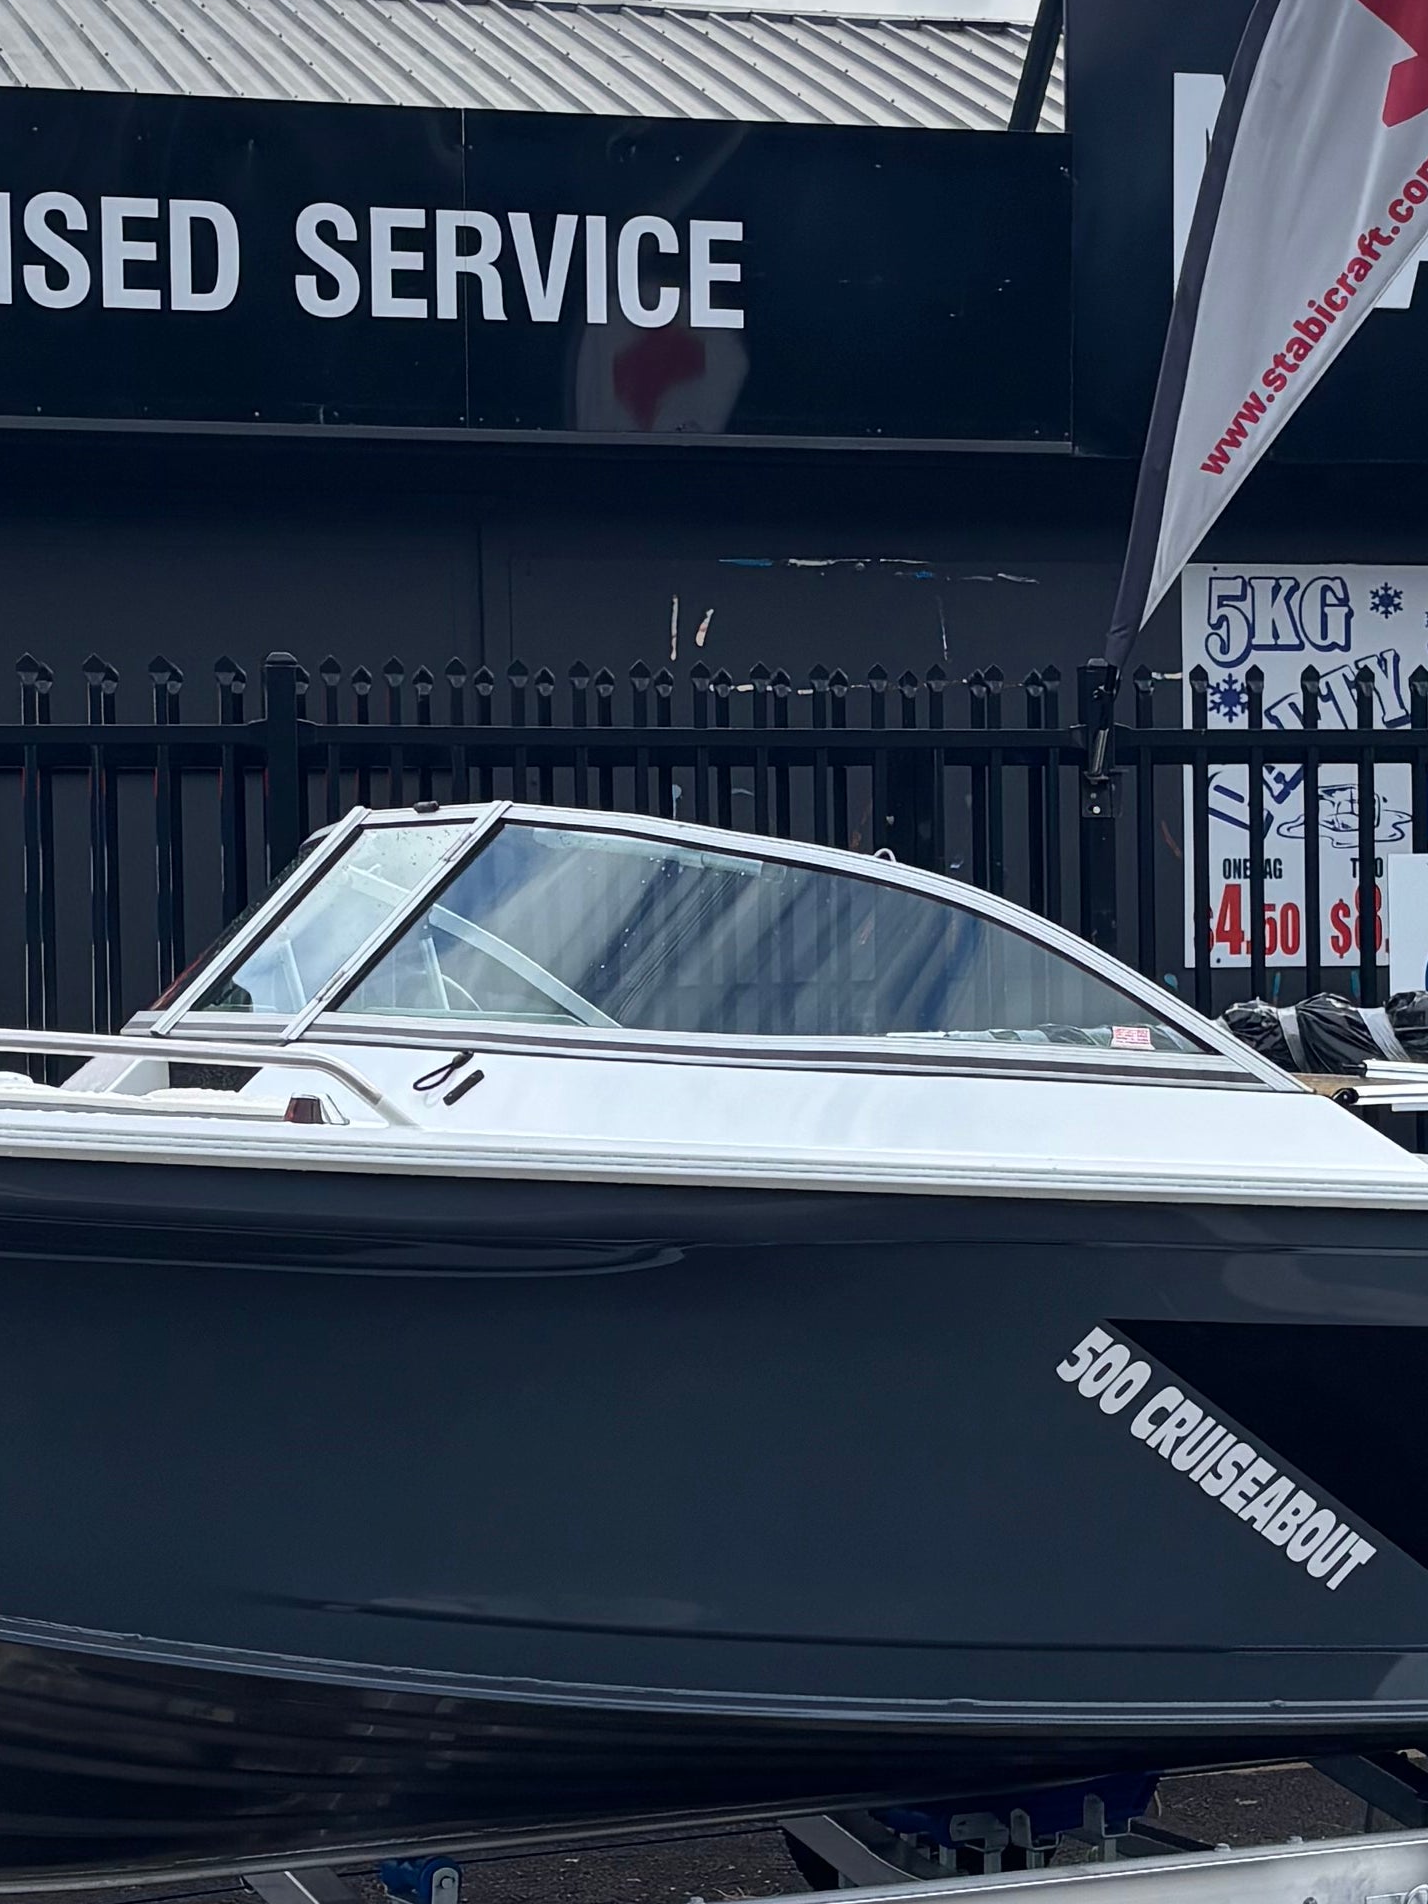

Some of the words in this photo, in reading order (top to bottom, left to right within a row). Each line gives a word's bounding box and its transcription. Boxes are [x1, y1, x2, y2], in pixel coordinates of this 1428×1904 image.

[294, 202, 745, 329] SERVICE
[1205, 576, 1354, 669] 5KG
[1055, 1326, 1152, 1415] 500
[1129, 1386, 1377, 1592] CRUISEABOUT
